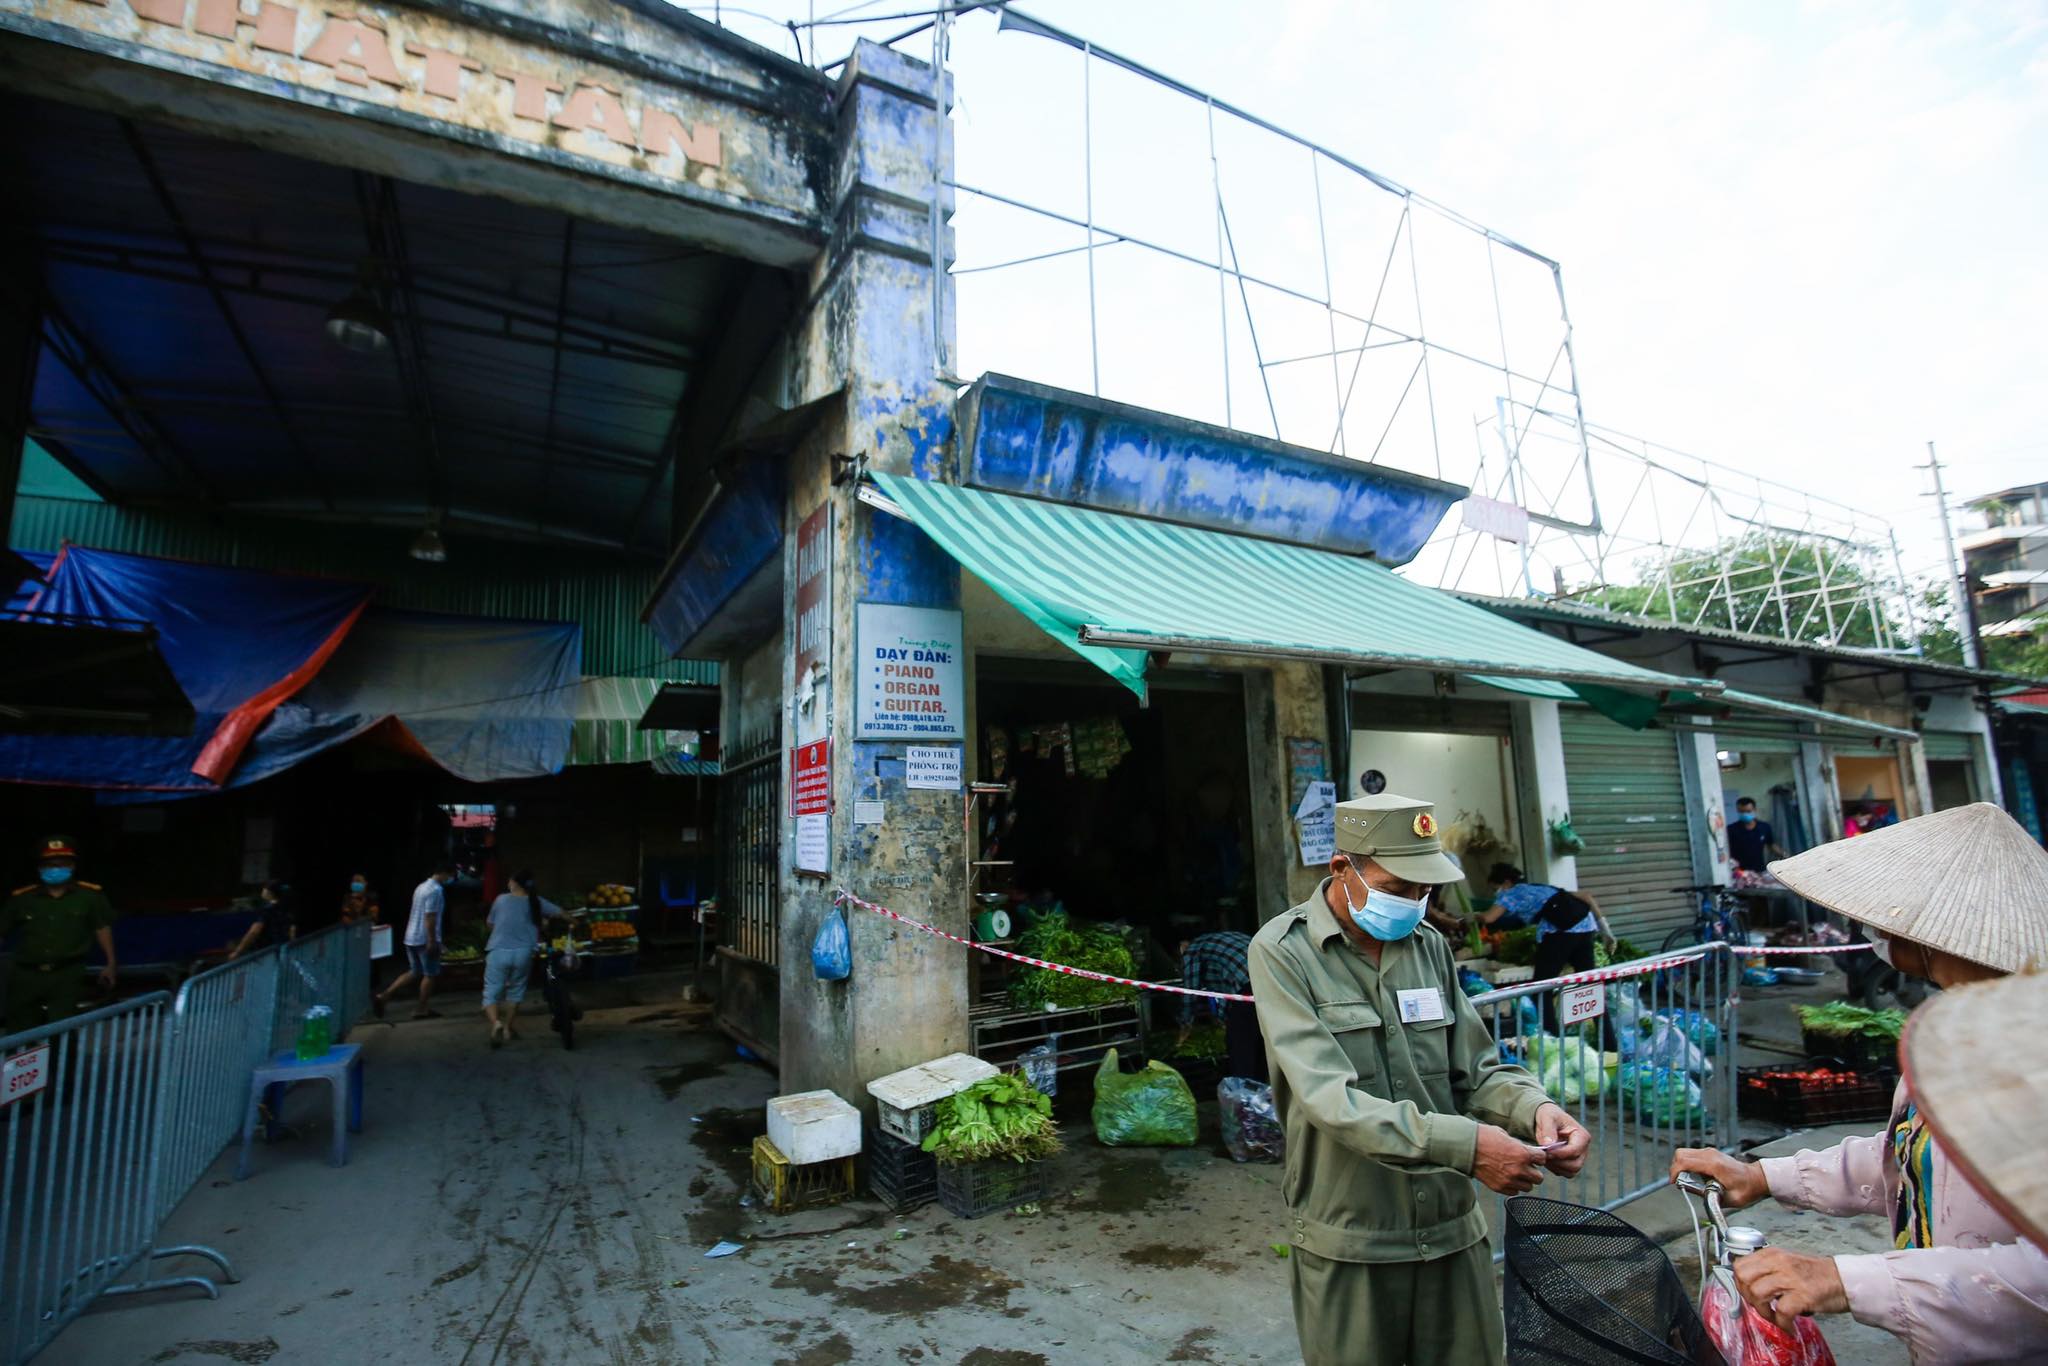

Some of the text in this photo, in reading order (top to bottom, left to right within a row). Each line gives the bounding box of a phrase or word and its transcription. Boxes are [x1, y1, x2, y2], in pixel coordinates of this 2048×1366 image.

[494, 69, 722, 168] TÂN
[876, 647, 952, 664] DẠY ĐÀN:
[884, 664, 934, 679] PIANO
[884, 681, 940, 696] ORGAN
[884, 698, 947, 714] GUITAR.
[875, 712, 889, 721] Liên
[911, 750, 931, 758] CHO
[908, 761, 959, 772] PHÒNG TRỌ
[1575, 989, 1593, 999] POLICE
[1572, 1000, 1597, 1016] STOP
[10, 1068, 39, 1092] STOP
